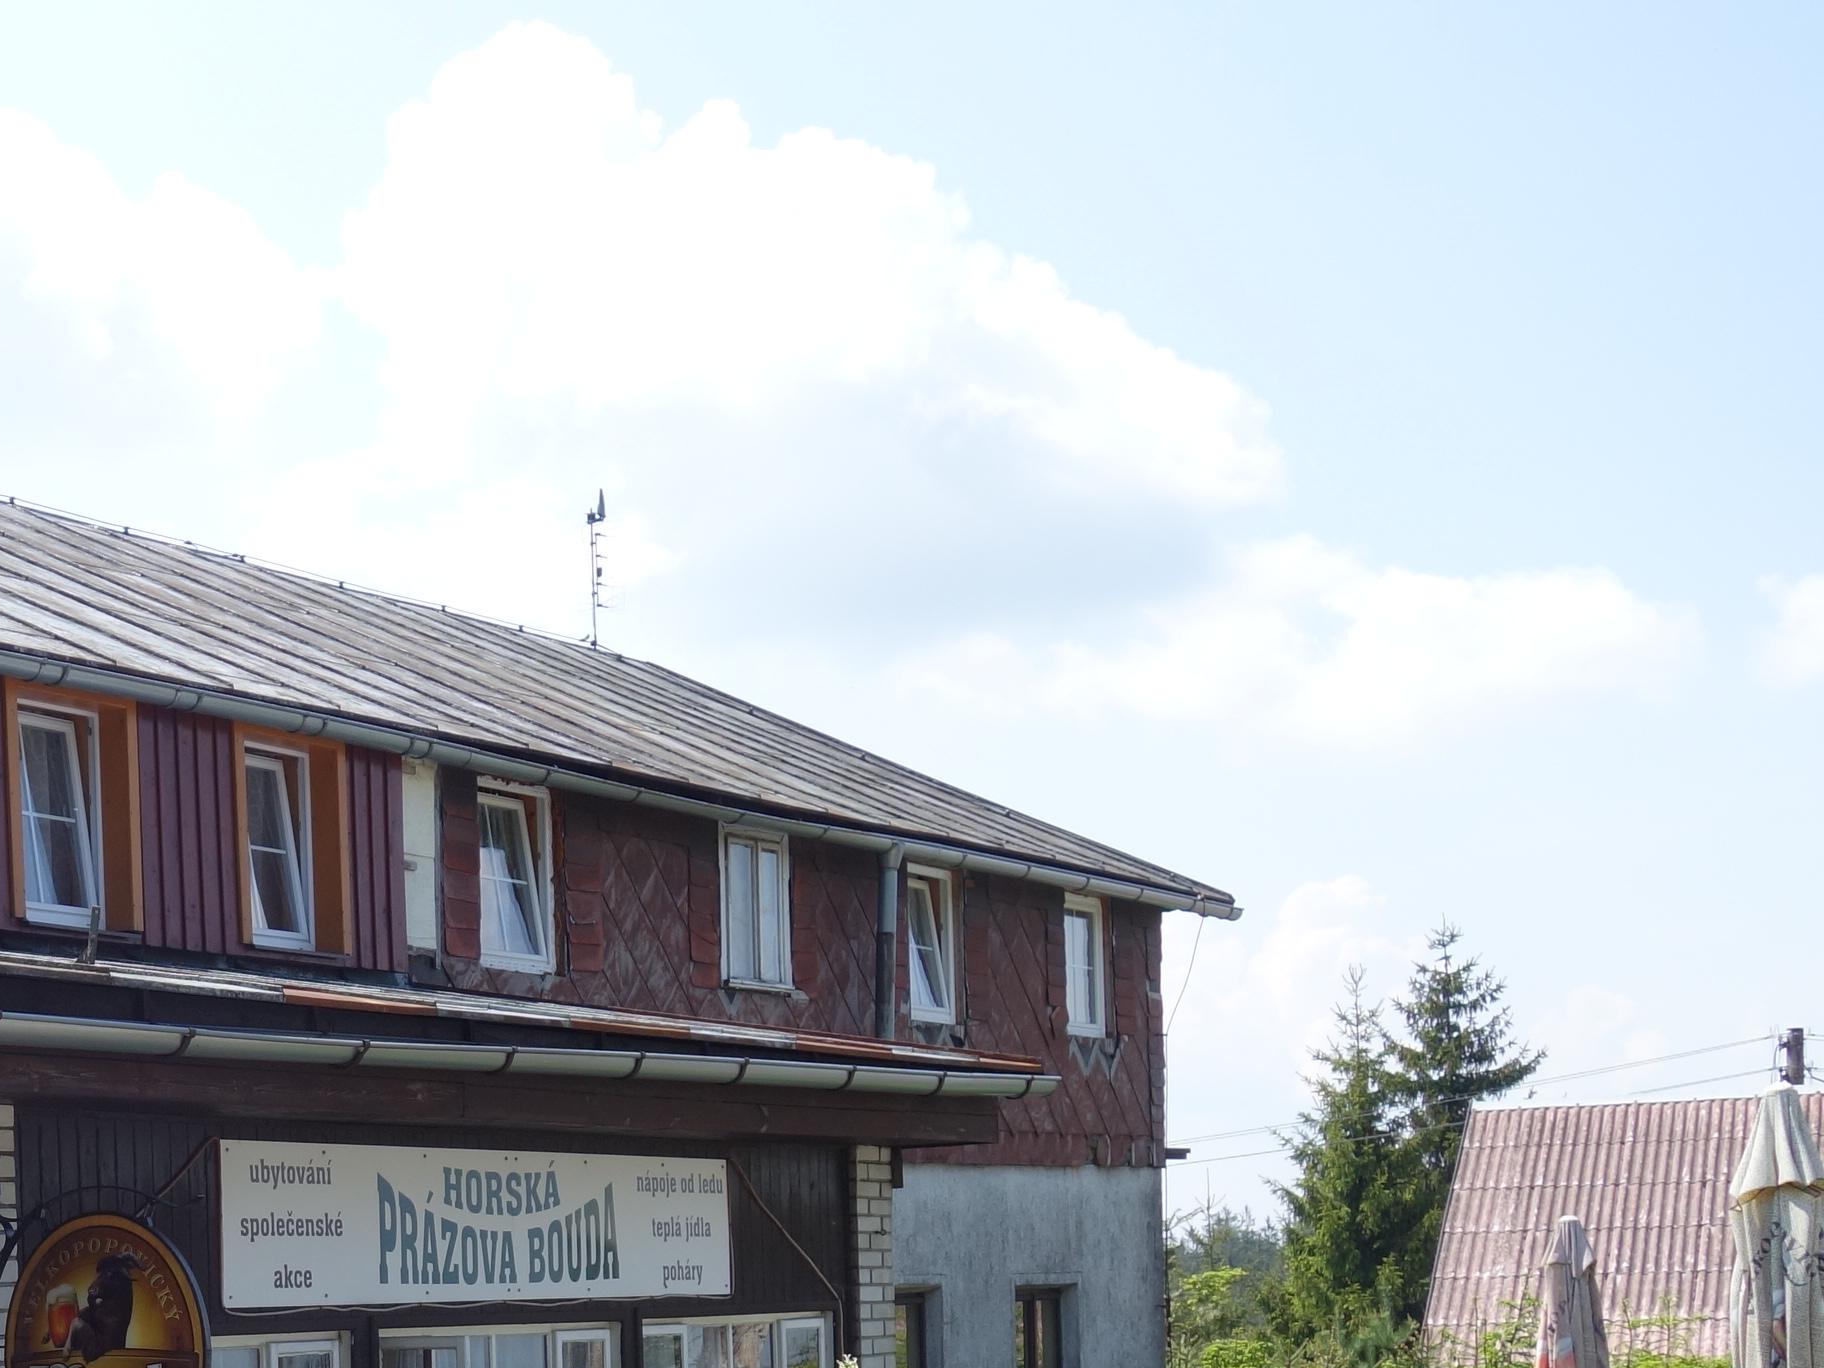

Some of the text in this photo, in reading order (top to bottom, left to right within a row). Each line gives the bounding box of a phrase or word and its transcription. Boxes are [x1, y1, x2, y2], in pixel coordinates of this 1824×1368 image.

[249, 1158, 332, 1190] ubytování
[442, 1159, 561, 1217] HORSKÁ
[636, 1169, 723, 1198] nápoje od ledu
[239, 1210, 344, 1243] společenské
[376, 1171, 620, 1286] PRÁZOVA BOUDA
[651, 1215, 712, 1242] teplá jídla
[273, 1263, 313, 1289] akce
[662, 1258, 703, 1289] poháry
